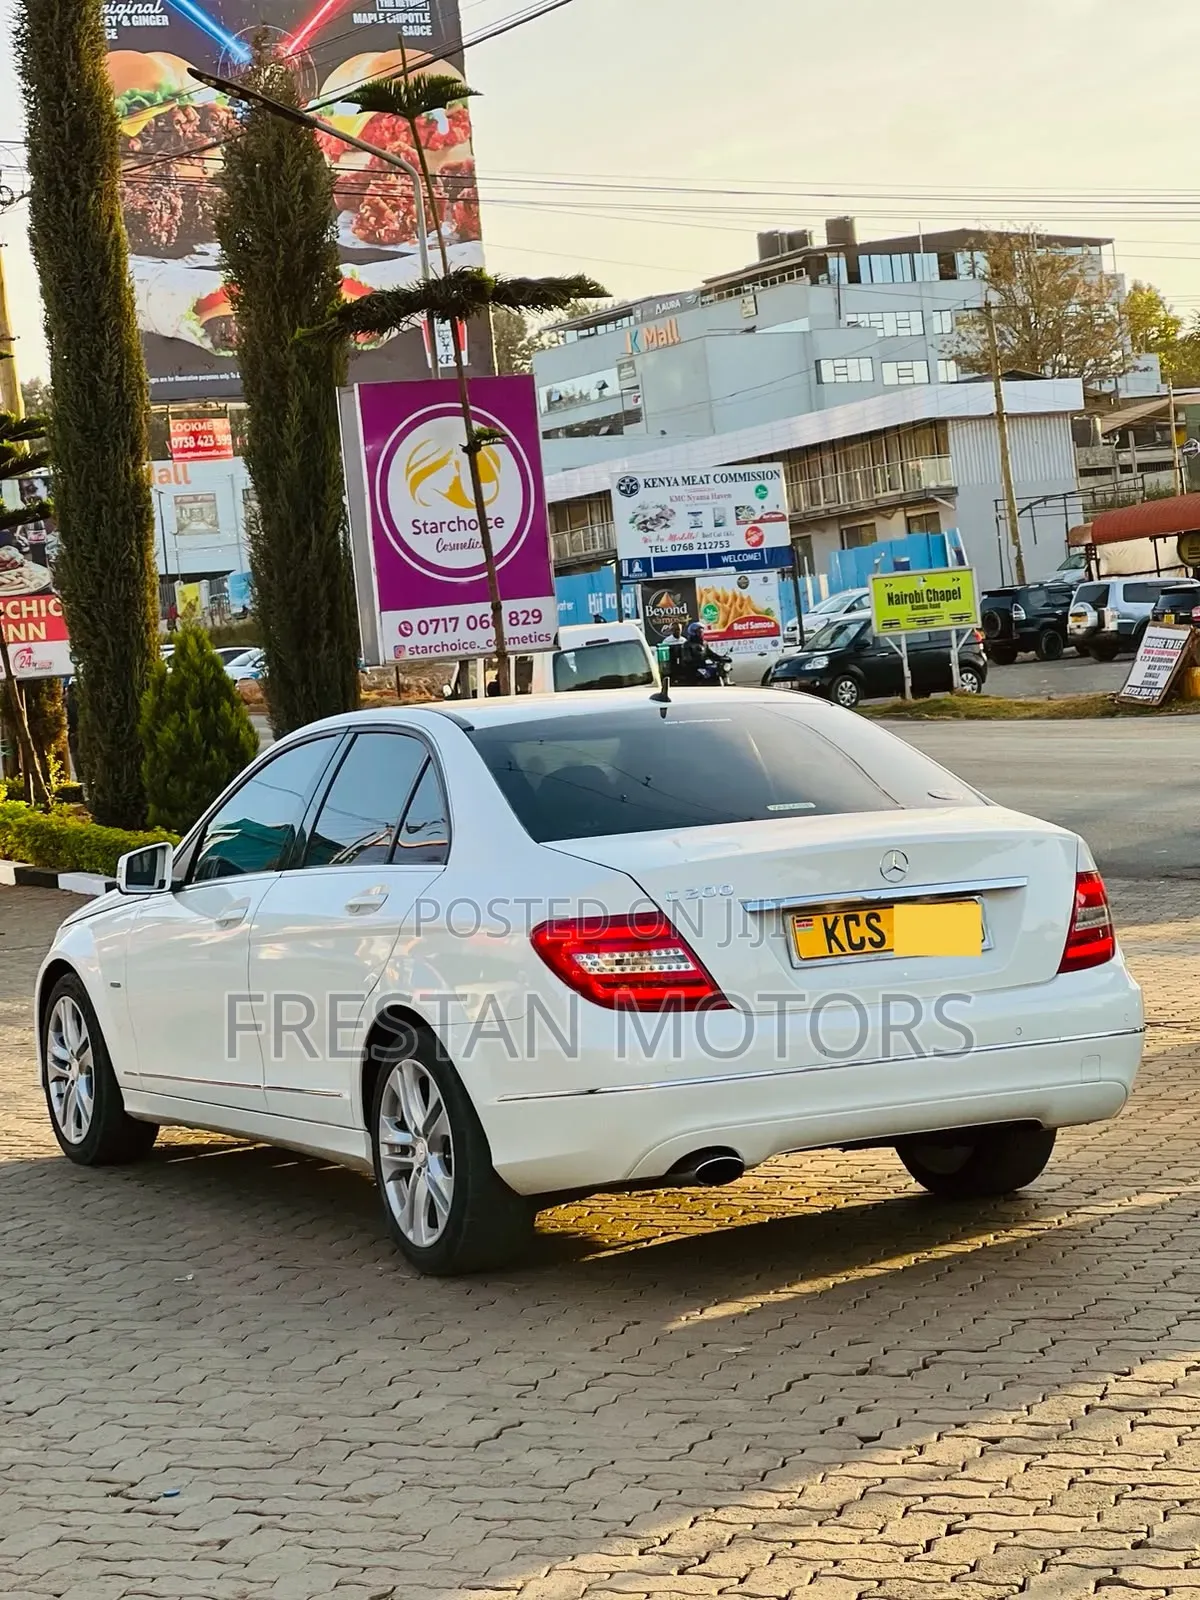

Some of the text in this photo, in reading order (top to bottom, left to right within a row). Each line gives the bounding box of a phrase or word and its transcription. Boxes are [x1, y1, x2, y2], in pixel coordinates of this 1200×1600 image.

[102, 0, 165, 21] riginal
[352, 12, 432, 24] MAPLE CHIPOTLE
[131, 15, 170, 26] GINGER
[402, 25, 433, 36] SAUCE
[625, 317, 682, 354] K Mall
[643, 469, 781, 488] KENYA MEAT COMMISSION
[411, 515, 505, 535] Starchoce
[436, 538, 485, 553] Cosmetic
[648, 540, 730, 553] TEL: 0768 212753
[721, 552, 761, 563] WELCOME!
[887, 586, 962, 606] Nairobi Chapel
[645, 603, 688, 617] Beyond
[417, 608, 543, 635] 0717 06 829
[685, 884, 734, 900] 200
[823, 911, 887, 953] KCS
